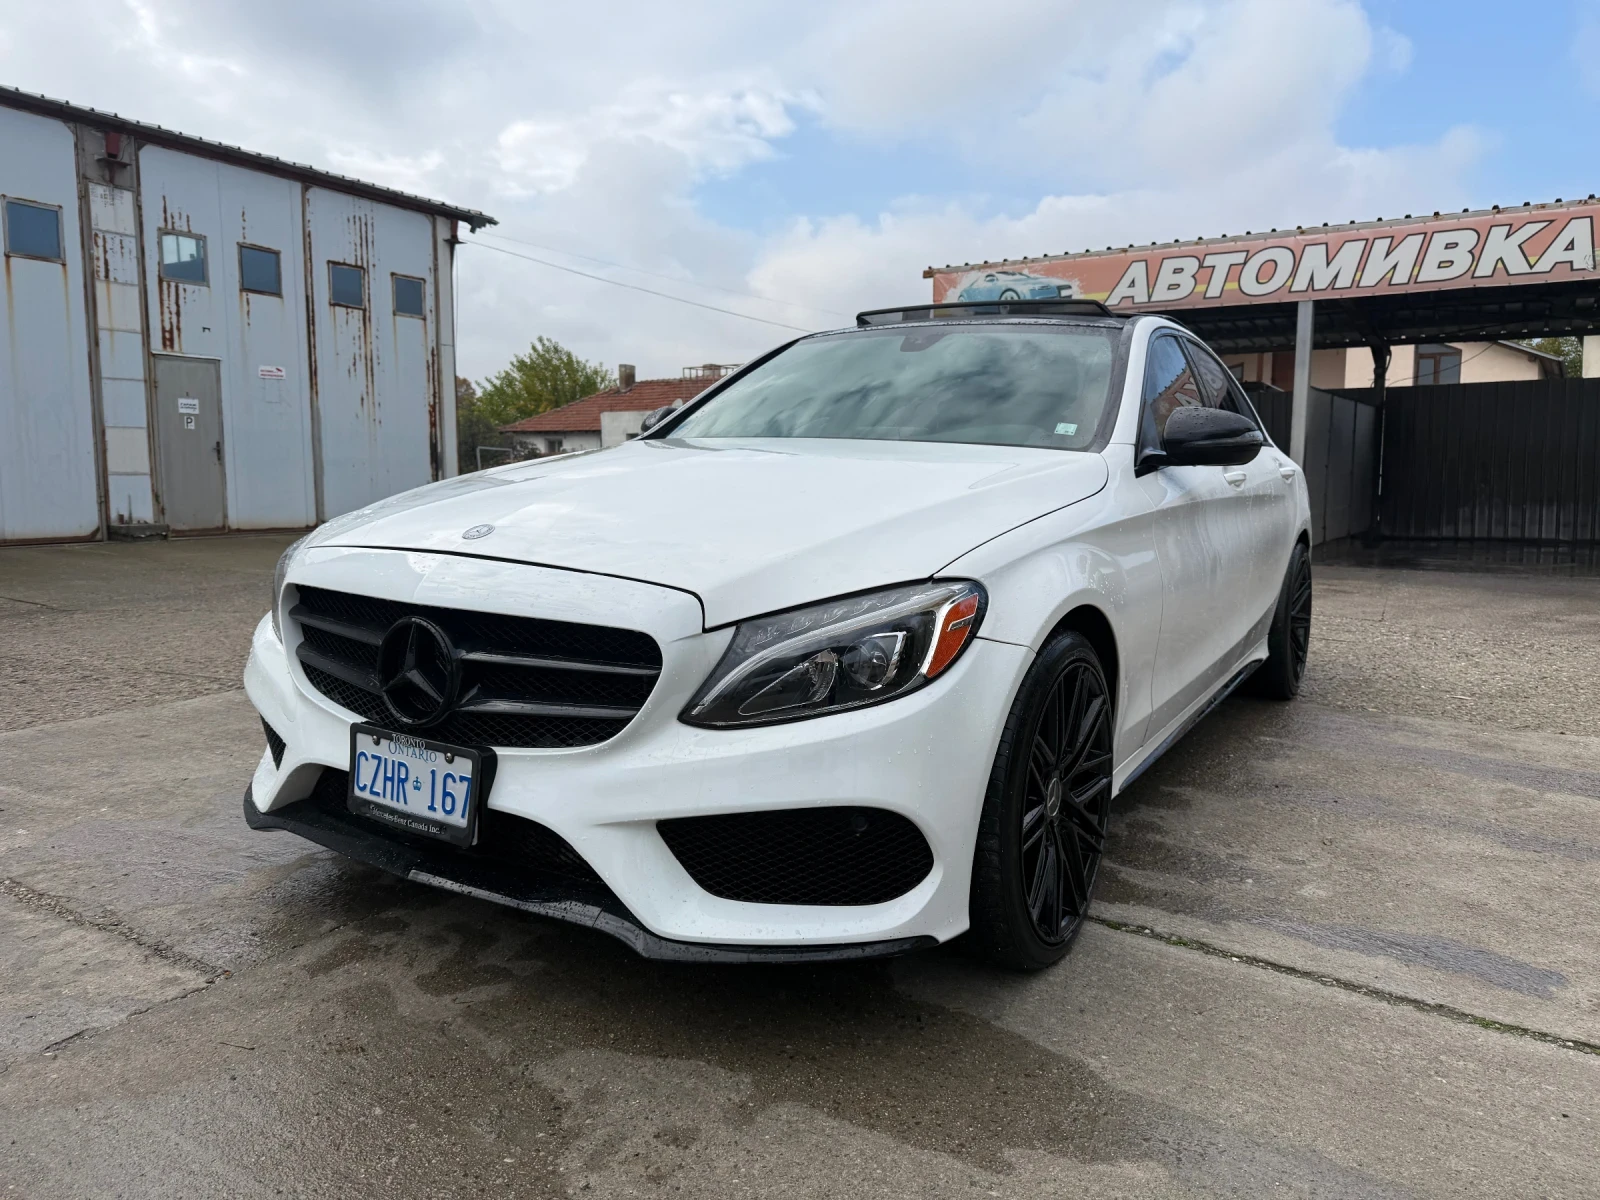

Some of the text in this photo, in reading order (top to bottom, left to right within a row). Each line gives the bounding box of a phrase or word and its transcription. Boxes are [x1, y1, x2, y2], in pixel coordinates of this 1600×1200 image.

[1103, 215, 1596, 307] АВТОМИВКА
[388, 741, 437, 763] ONTARIO
[391, 733, 426, 750] TORONTO
[355, 751, 472, 819] CZHR 167
[407, 819, 428, 832] Canada
